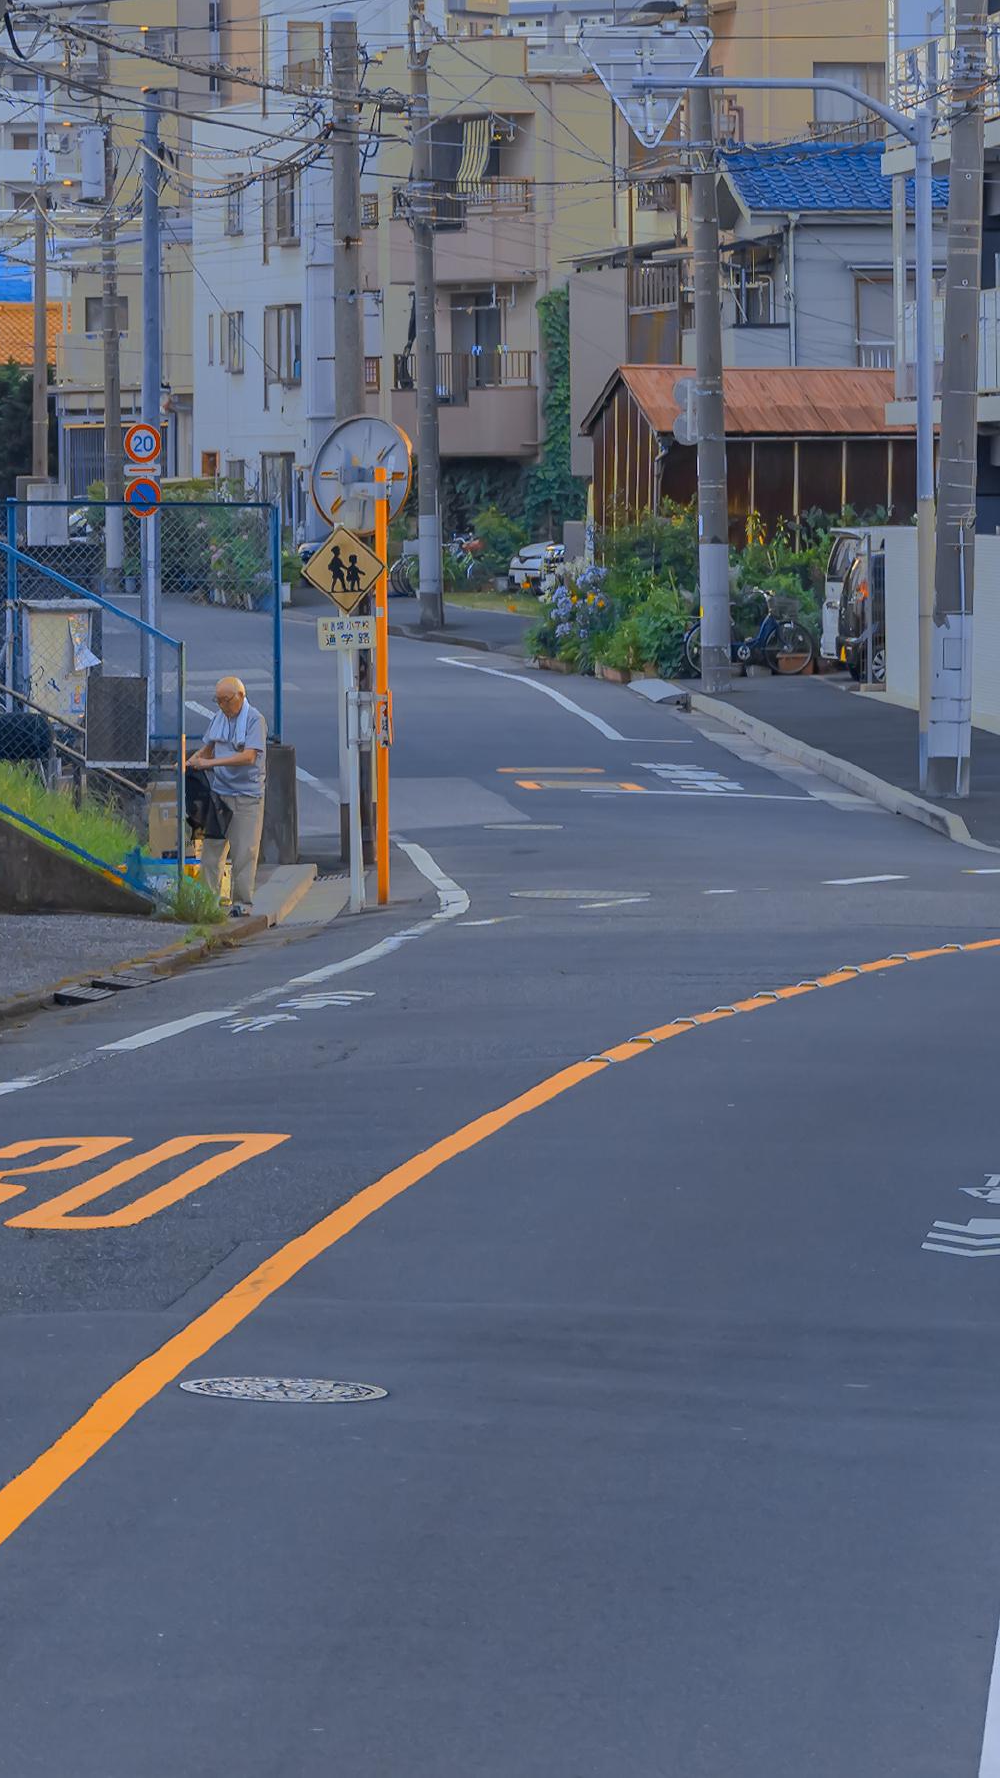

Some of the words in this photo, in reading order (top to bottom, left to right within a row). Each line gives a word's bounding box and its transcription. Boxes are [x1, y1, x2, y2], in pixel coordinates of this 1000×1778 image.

[133, 435, 154, 453] 20
[324, 632, 370, 646] 通学路
